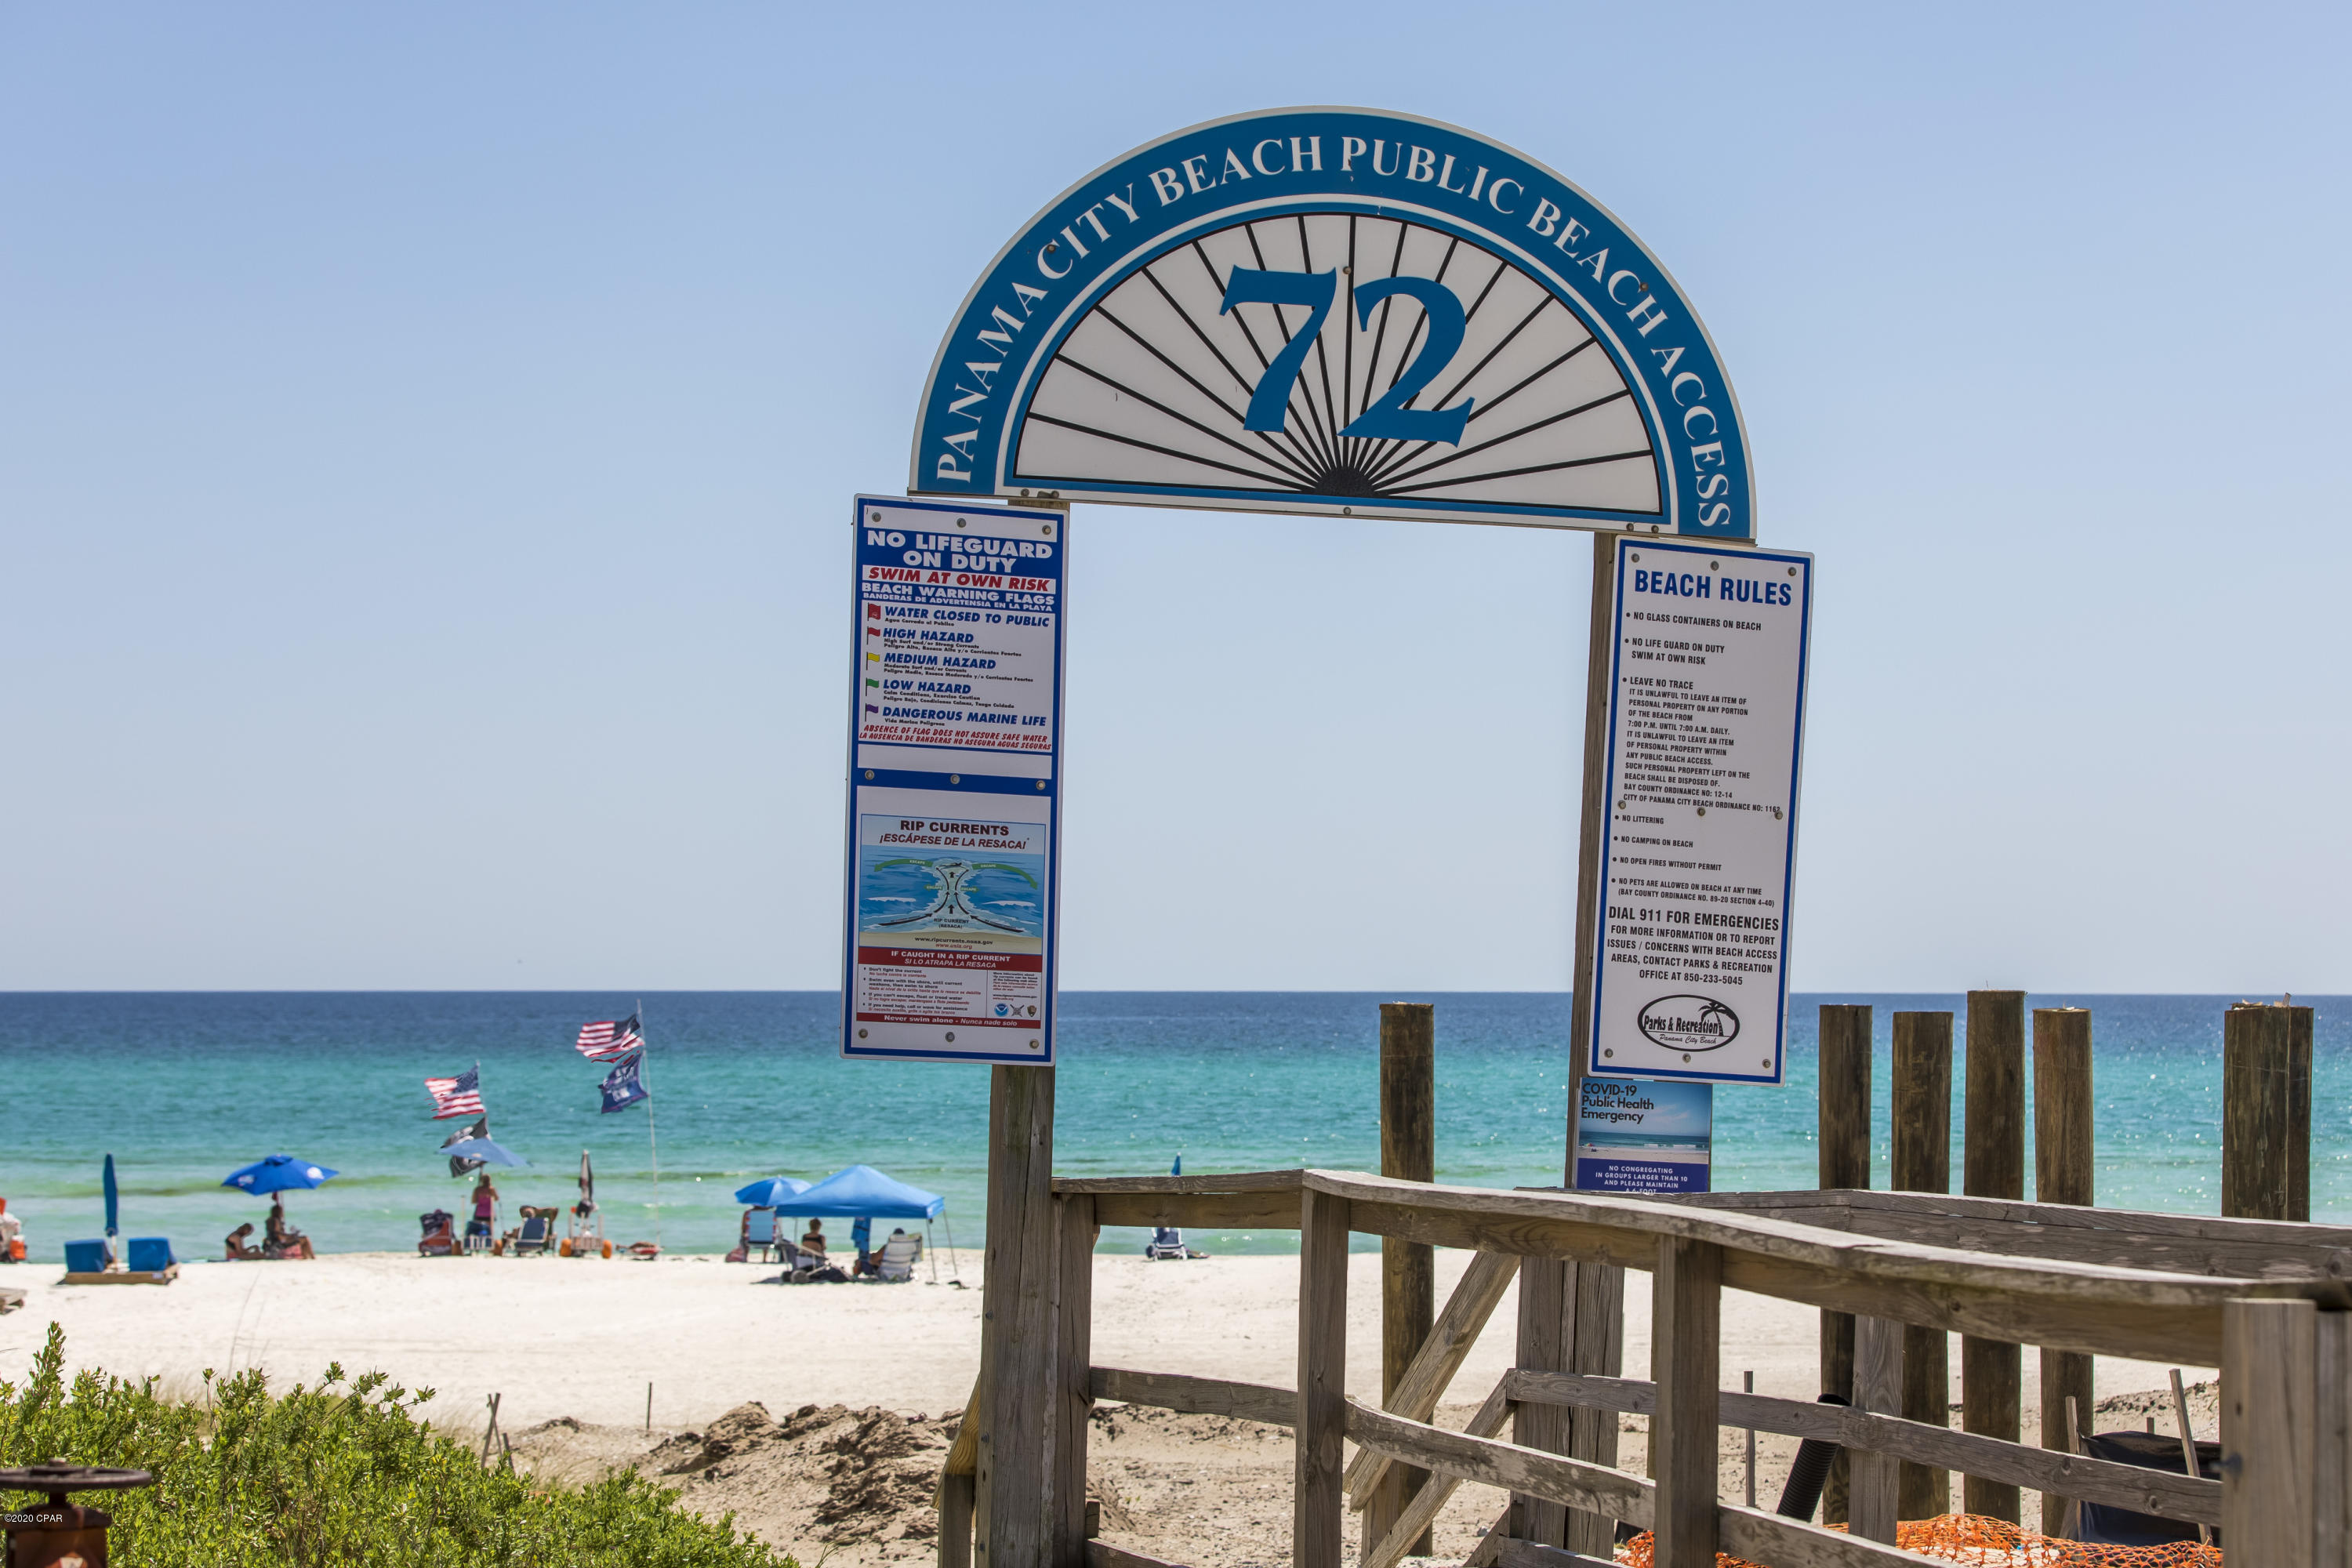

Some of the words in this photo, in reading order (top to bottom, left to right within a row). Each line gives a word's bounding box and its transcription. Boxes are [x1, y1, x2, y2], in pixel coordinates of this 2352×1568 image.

[937, 282, 1049, 483] PANAMA
[1036, 183, 1140, 280] CITY
[1149, 136, 1323, 208] BEACH
[1341, 136, 1524, 214] PUBLIC
[1526, 197, 1668, 339] BEACH
[1651, 345, 1730, 527] ACCESS
[1219, 264, 1475, 448] 72
[867, 530, 906, 547] NO
[916, 533, 1052, 558] LIFEGUARD
[902, 550, 941, 567] ON
[951, 554, 1016, 572] DUTY
[868, 566, 920, 582] SWIM
[927, 571, 951, 584] AT
[956, 573, 1003, 588] OWN
[1008, 577, 1049, 591] RISK
[862, 582, 912, 595] BEACH
[919, 586, 999, 601] WARNING
[1005, 593, 1054, 604] FLAGS
[1635, 569, 1710, 598] BEACH
[1720, 577, 1791, 606] RULES
[863, 592, 912, 602] BANDERAS
[913, 596, 927, 604] DE
[928, 597, 990, 607] ADVERTENSIA
[1022, 602, 1052, 611] PLAYA
[884, 605, 928, 619] WATER
[933, 609, 980, 622] CLOSED
[985, 613, 1001, 623] TO
[1005, 615, 1049, 627] PUBLIC
[1633, 612, 1643, 620] NO
[1646, 612, 1670, 622] GLASS
[1672, 615, 1720, 626] CONTAINERS
[1722, 619, 1733, 628] ON
[1735, 620, 1761, 630] BEACH
[883, 627, 916, 641] HIGH
[920, 630, 974, 643] HAZARD
[1632, 637, 1642, 646] NO
[1645, 638, 1661, 648] LIFE
[1664, 640, 1690, 650] GUARD
[1692, 643, 1702, 652] ON
[1704, 644, 1724, 653] DUTY
[884, 652, 938, 666] MEDIUM
[942, 656, 996, 669] HAZARD
[1631, 650, 1653, 659] SWIM
[1655, 652, 1665, 661] AT
[1667, 653, 1685, 662] OWN
[1688, 655, 1705, 665] RISK
[883, 679, 913, 691] LOW
[917, 681, 971, 694] HAZARD
[1630, 676, 1653, 686] LEAVE
[1656, 678, 1666, 687] NO
[1668, 680, 1693, 689] TRACE
[882, 706, 962, 720] DANGEROUS
[966, 712, 1018, 724] MARINE
[1022, 715, 1046, 726] LIFE
[1674, 713, 1693, 721] FROM
[863, 724, 898, 735] ABSENCE
[900, 727, 911, 735] OF
[911, 727, 931, 736] FLAG
[931, 728, 953, 737] DOES
[970, 731, 1000, 739] ASSURE
[1022, 734, 1047, 742] WATER
[1664, 786, 1699, 796] ORDINANCE
[900, 819, 924, 830] RIP
[929, 822, 1009, 836] CURRENTS
[1632, 815, 1664, 824] LITTERING
[879, 833, 942, 844] ¡ESCÁPESE
[943, 837, 960, 845] DE
[961, 837, 975, 847] LA
[978, 838, 1025, 849] RESACA!
[1631, 836, 1660, 844] CAMPING
[1668, 860, 1696, 869] WITHOUT
[1660, 891, 1696, 900] ORDINANCE
[1730, 896, 1755, 905] SECTION
[1757, 898, 1774, 907] 4-40)
[1608, 906, 1635, 920] DIAL
[1639, 908, 1661, 921] 911
[1666, 910, 1690, 924] FOR
[1694, 913, 1778, 931] EMERGENCIES
[1639, 969, 1668, 979] OFFICE
[1671, 971, 1681, 980] AT
[1683, 972, 1742, 985] 850-233-5045
[1644, 1015, 1666, 1031] Parks
[1668, 1017, 1674, 1032] &
[1676, 1018, 1719, 1034] Recreation
[1685, 1036, 1697, 1044] City
[1582, 1083, 1637, 1096] COVID-19
[1581, 1095, 1614, 1107] Public
[1617, 1098, 1654, 1109] Health
[1581, 1108, 1644, 1124] Emergency
